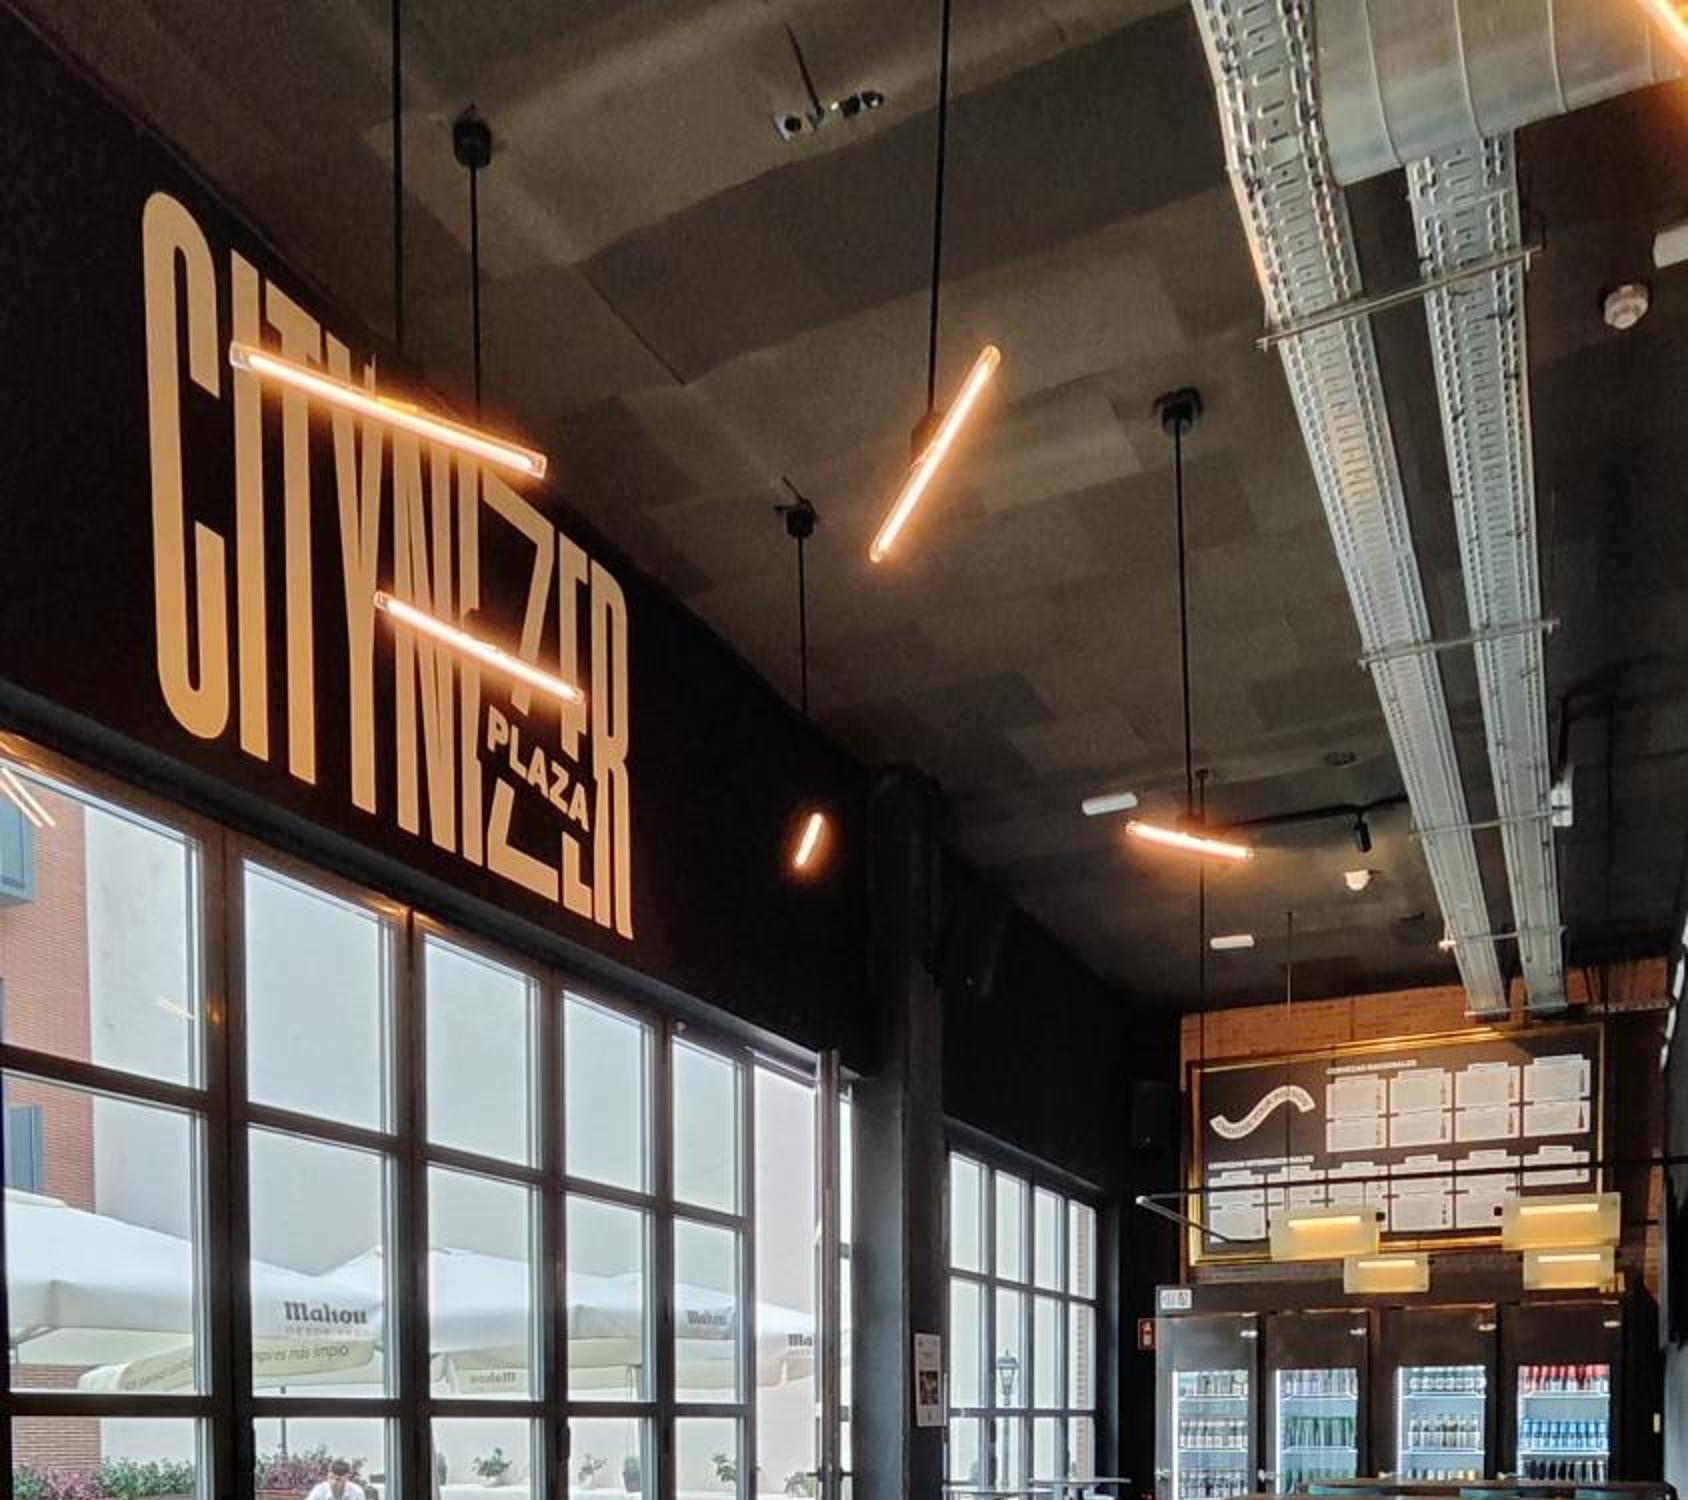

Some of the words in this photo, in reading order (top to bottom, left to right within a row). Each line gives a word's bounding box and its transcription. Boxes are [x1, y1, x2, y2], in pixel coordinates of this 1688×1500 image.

[142, 191, 634, 941] CITYNIZER
[487, 704, 590, 833] PLAZA
[284, 1301, 368, 1324] Mahou
